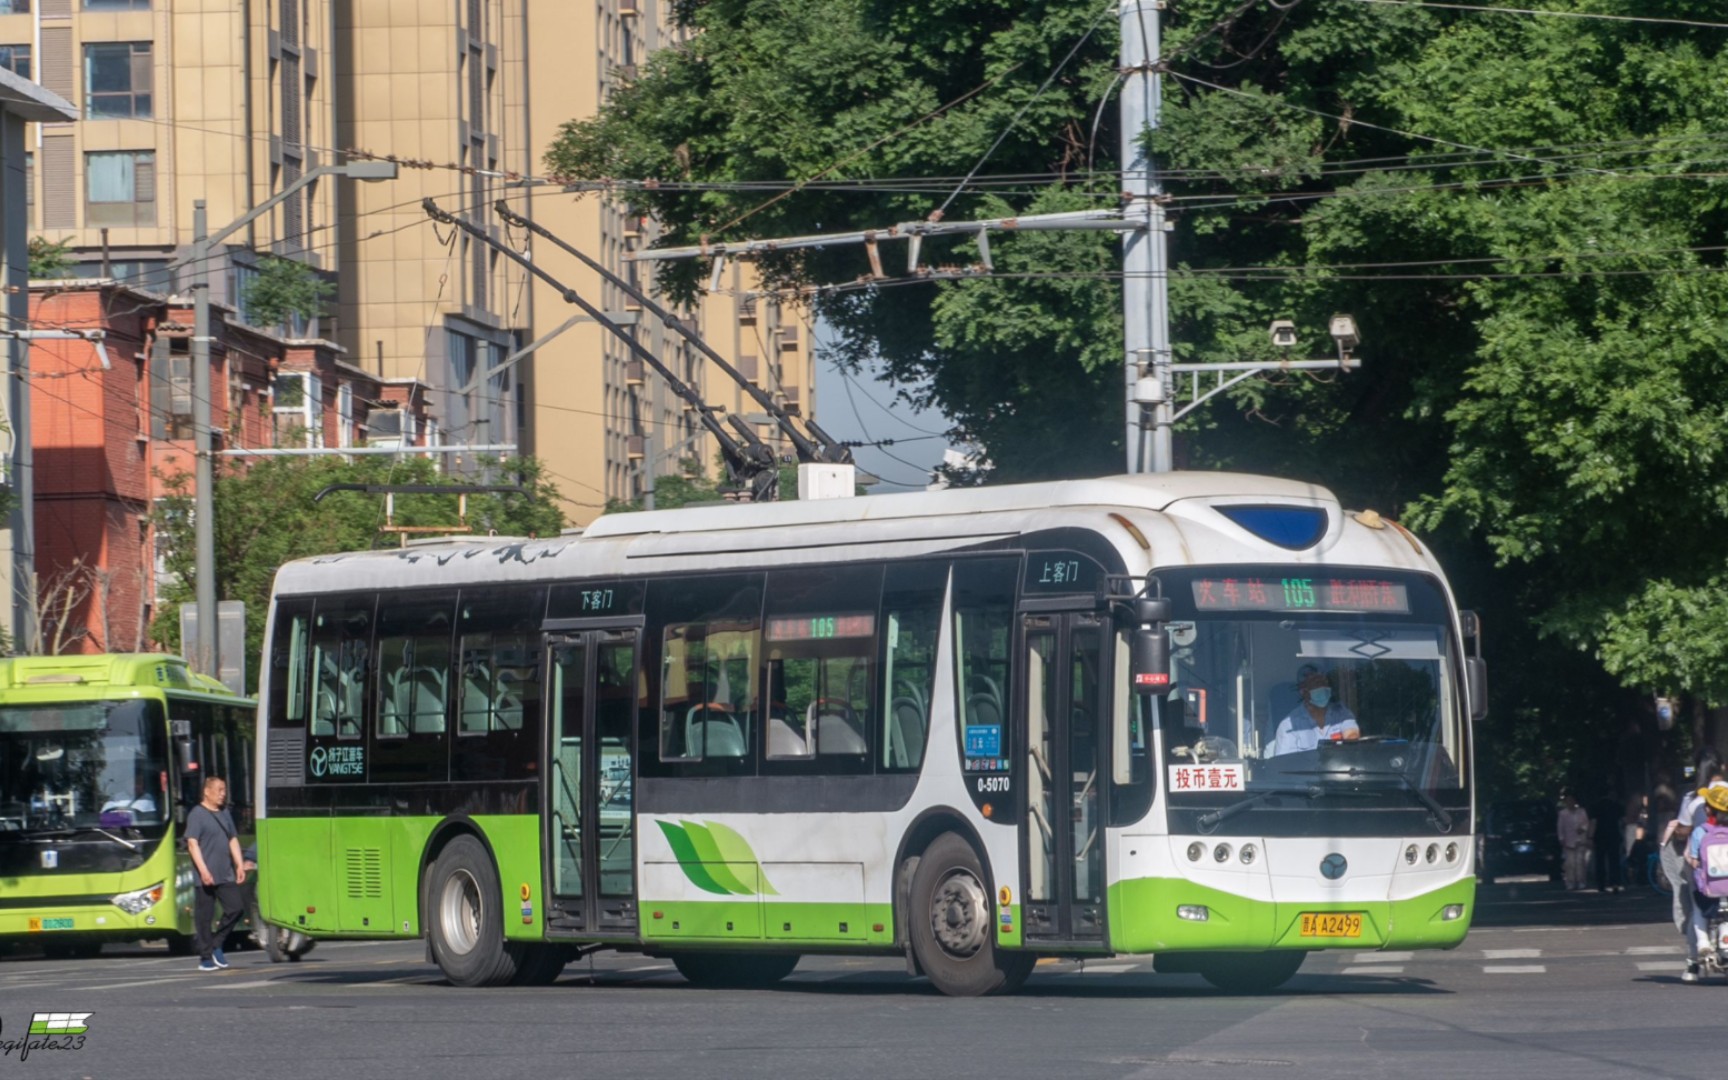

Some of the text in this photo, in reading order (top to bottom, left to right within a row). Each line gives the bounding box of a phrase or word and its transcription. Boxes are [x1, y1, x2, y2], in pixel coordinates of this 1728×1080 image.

[1039, 560, 1079, 583] 上客门
[581, 589, 613, 610] 下客门
[1281, 578, 1315, 608] 105
[811, 617, 835, 639] 105
[329, 762, 364, 775] YANGTSE
[1176, 767, 1237, 789] 投币壹元
[977, 776, 1010, 792] 0-5070
